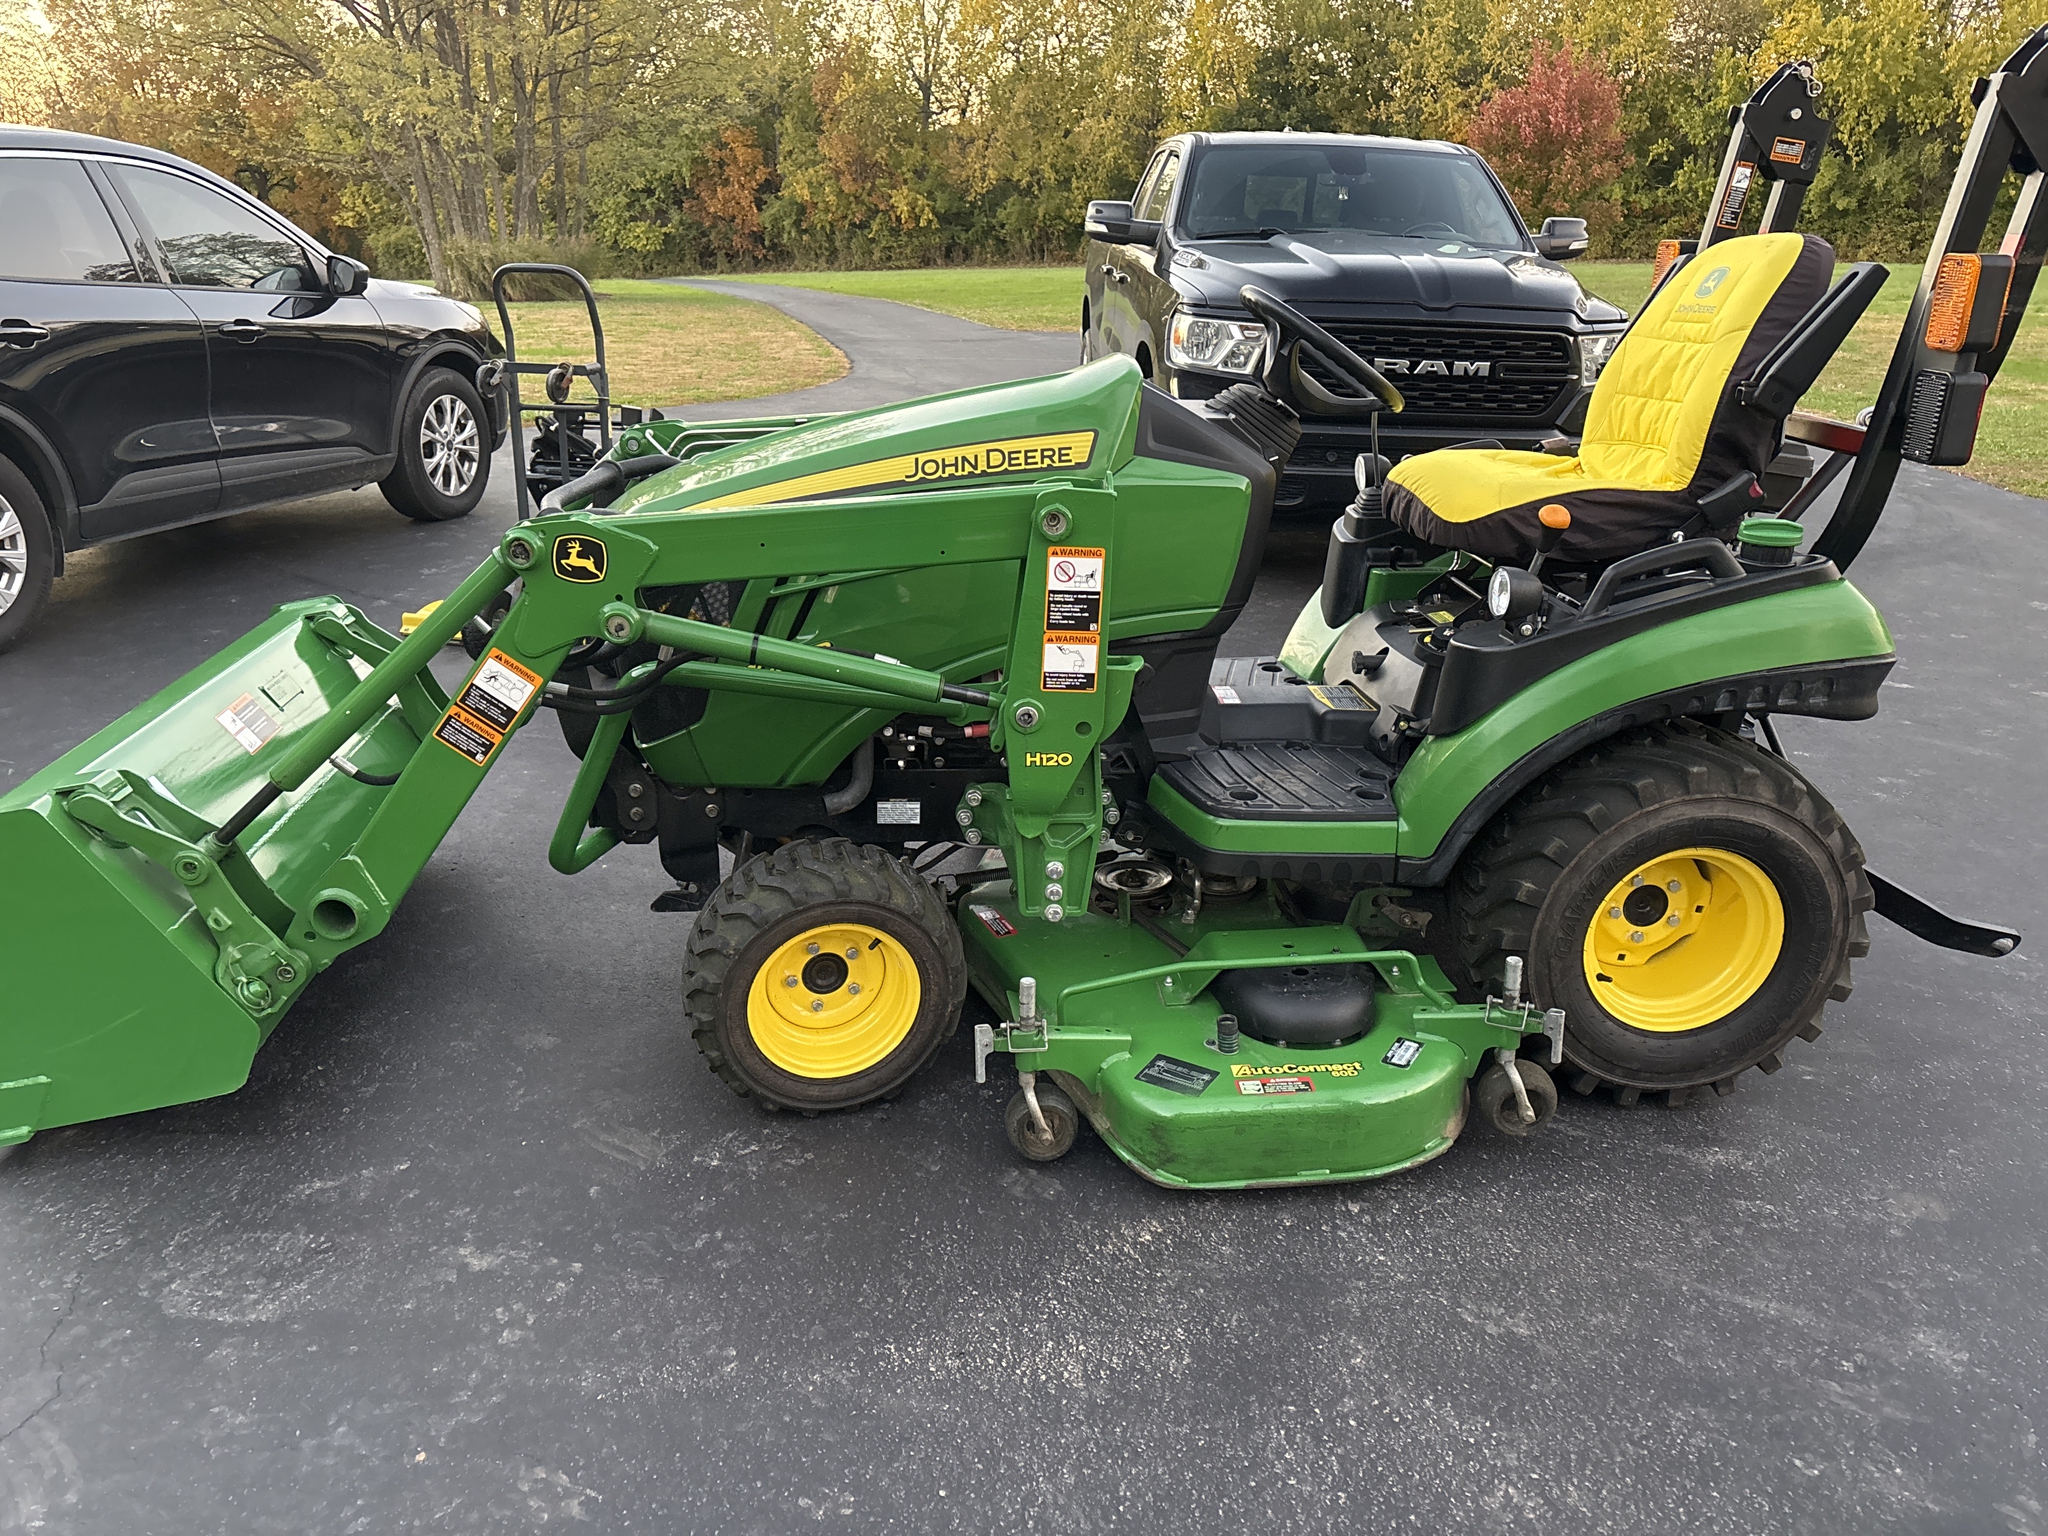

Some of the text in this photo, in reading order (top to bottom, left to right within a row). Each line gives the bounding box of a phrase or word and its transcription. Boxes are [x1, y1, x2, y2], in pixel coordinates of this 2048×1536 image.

[1374, 357, 1491, 377] RAM
[905, 446, 1073, 479] JOHN DEERE
[1060, 548, 1103, 557] WARNING
[1055, 635, 1097, 644] WARNING
[503, 658, 536, 683] WARNING
[463, 716, 496, 740] WARNING
[1026, 752, 1073, 767] H120
[1233, 1061, 1364, 1077] AutoConnect
